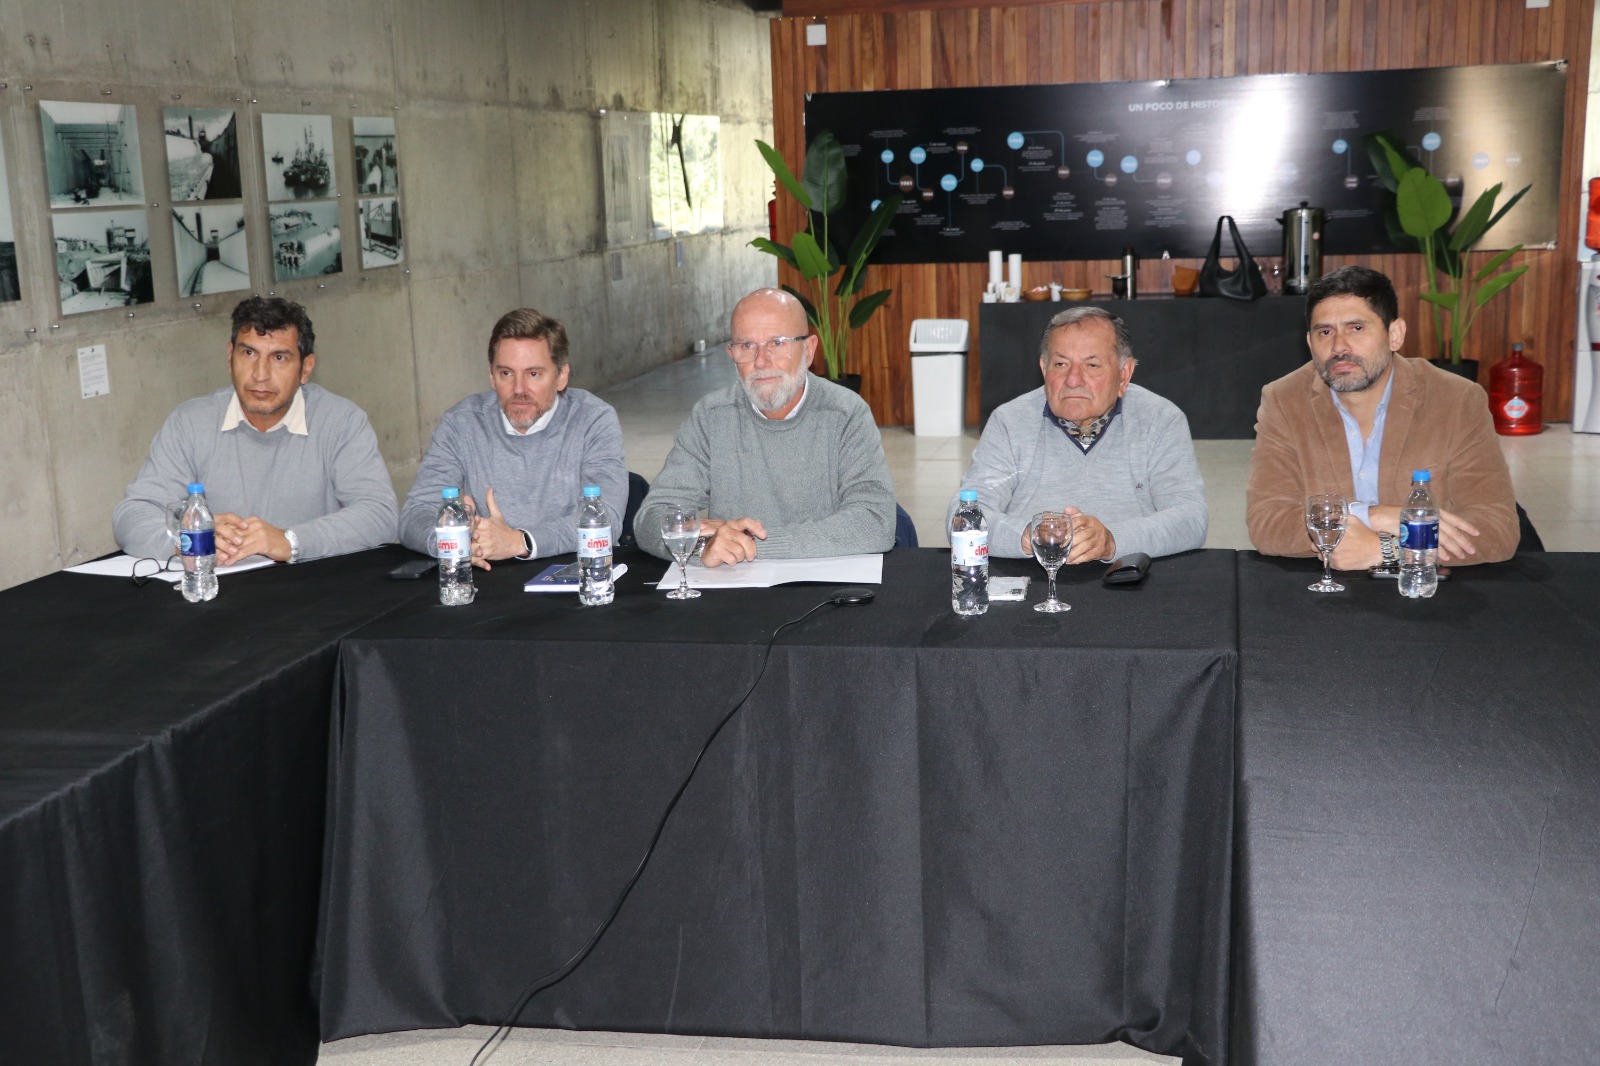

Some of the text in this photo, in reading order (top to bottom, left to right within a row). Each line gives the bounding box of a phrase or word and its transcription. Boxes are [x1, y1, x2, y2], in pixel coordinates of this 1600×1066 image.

[1128, 103, 1143, 112] UN
[1145, 102, 1173, 111] POCO
[1176, 101, 1189, 110] DE
